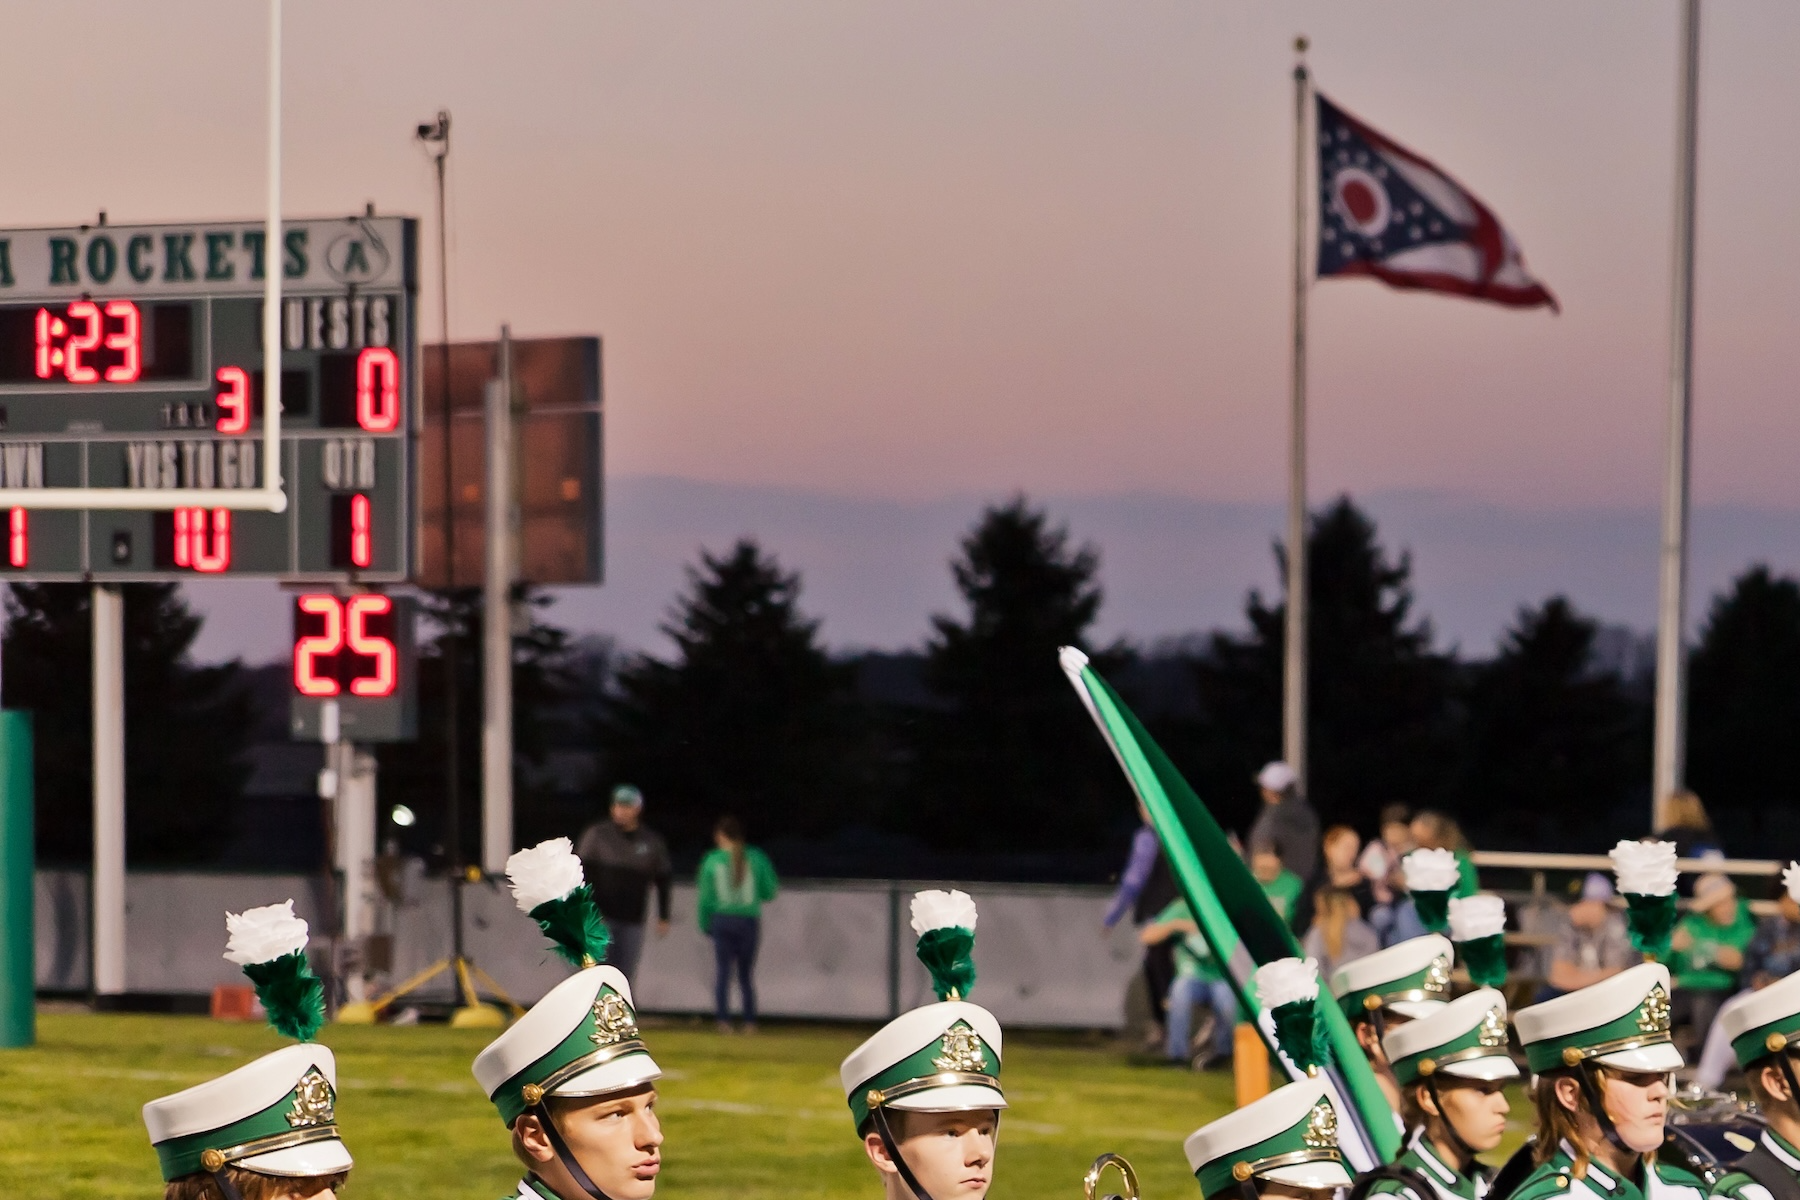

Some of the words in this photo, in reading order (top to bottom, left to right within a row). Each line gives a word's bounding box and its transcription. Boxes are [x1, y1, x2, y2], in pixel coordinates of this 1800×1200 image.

[49, 229, 308, 285] ROCKETS
[36, 300, 141, 383] 1:23
[215, 366, 250, 434] 3
[356, 347, 398, 433] 0
[9, 504, 28, 567] 1
[351, 494, 371, 567] 1
[294, 594, 397, 697] 25
